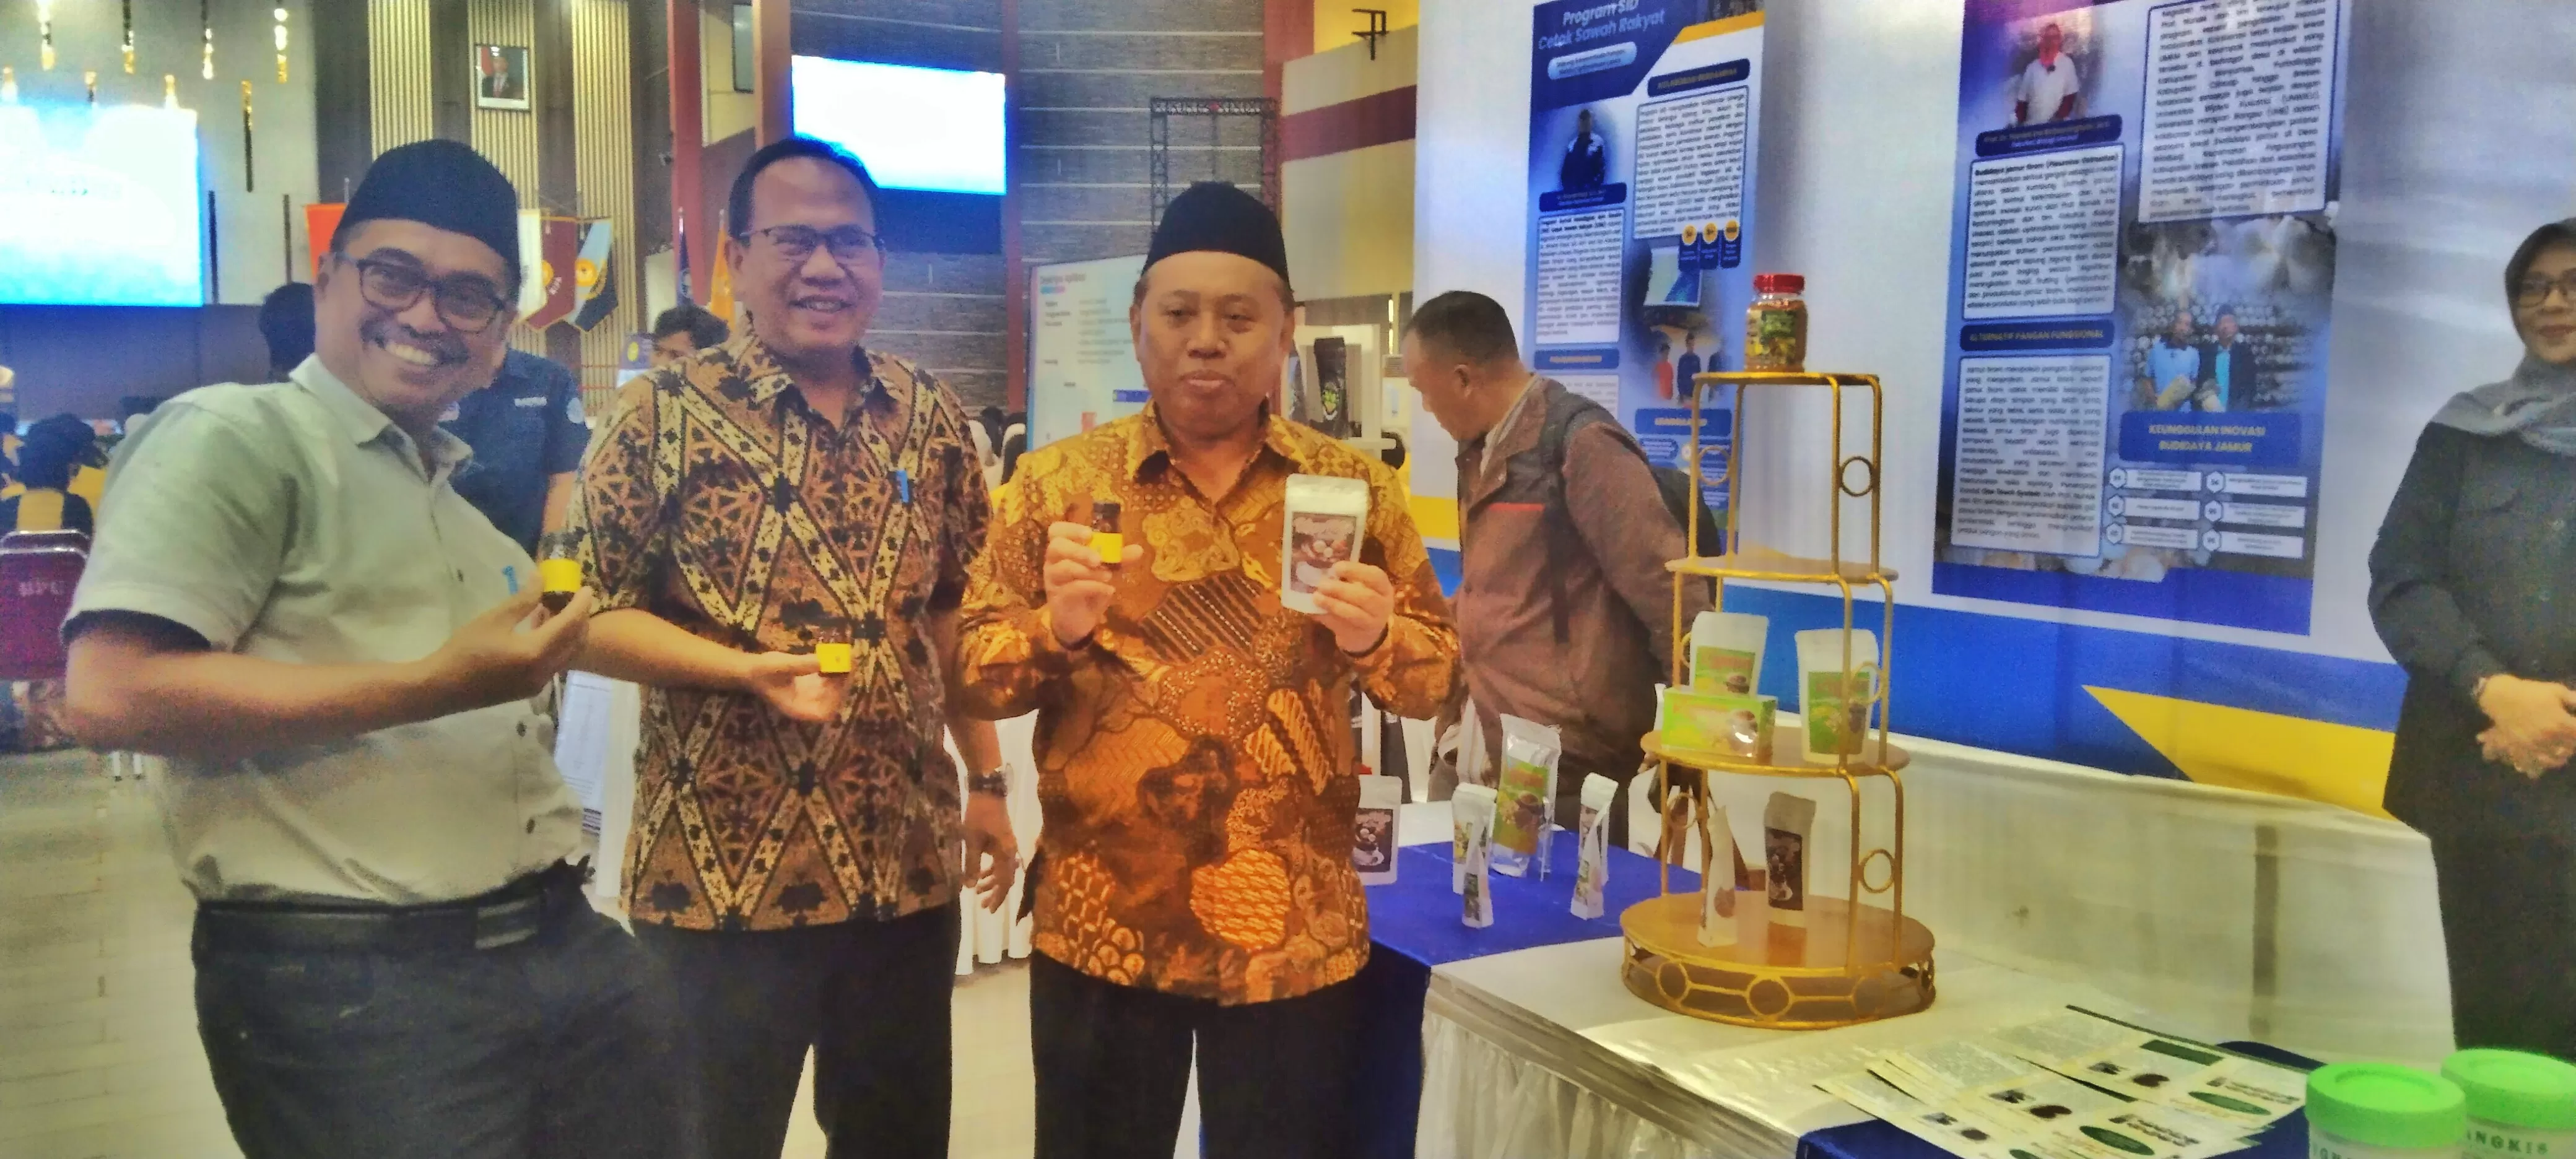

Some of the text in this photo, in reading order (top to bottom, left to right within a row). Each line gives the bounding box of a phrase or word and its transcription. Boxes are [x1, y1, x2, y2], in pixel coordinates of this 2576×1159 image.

[1562, 4, 1616, 26] Program
[1538, 9, 1665, 50] Cetak Sawah Rakyat
[2016, 330, 2049, 341] PANGAN
[2050, 329, 2104, 339] FUNGSIONAL
[2148, 423, 2266, 437] KEUNGGULAN INOVASI
[2159, 440, 2253, 453] BUDIDAYA JAMUR
